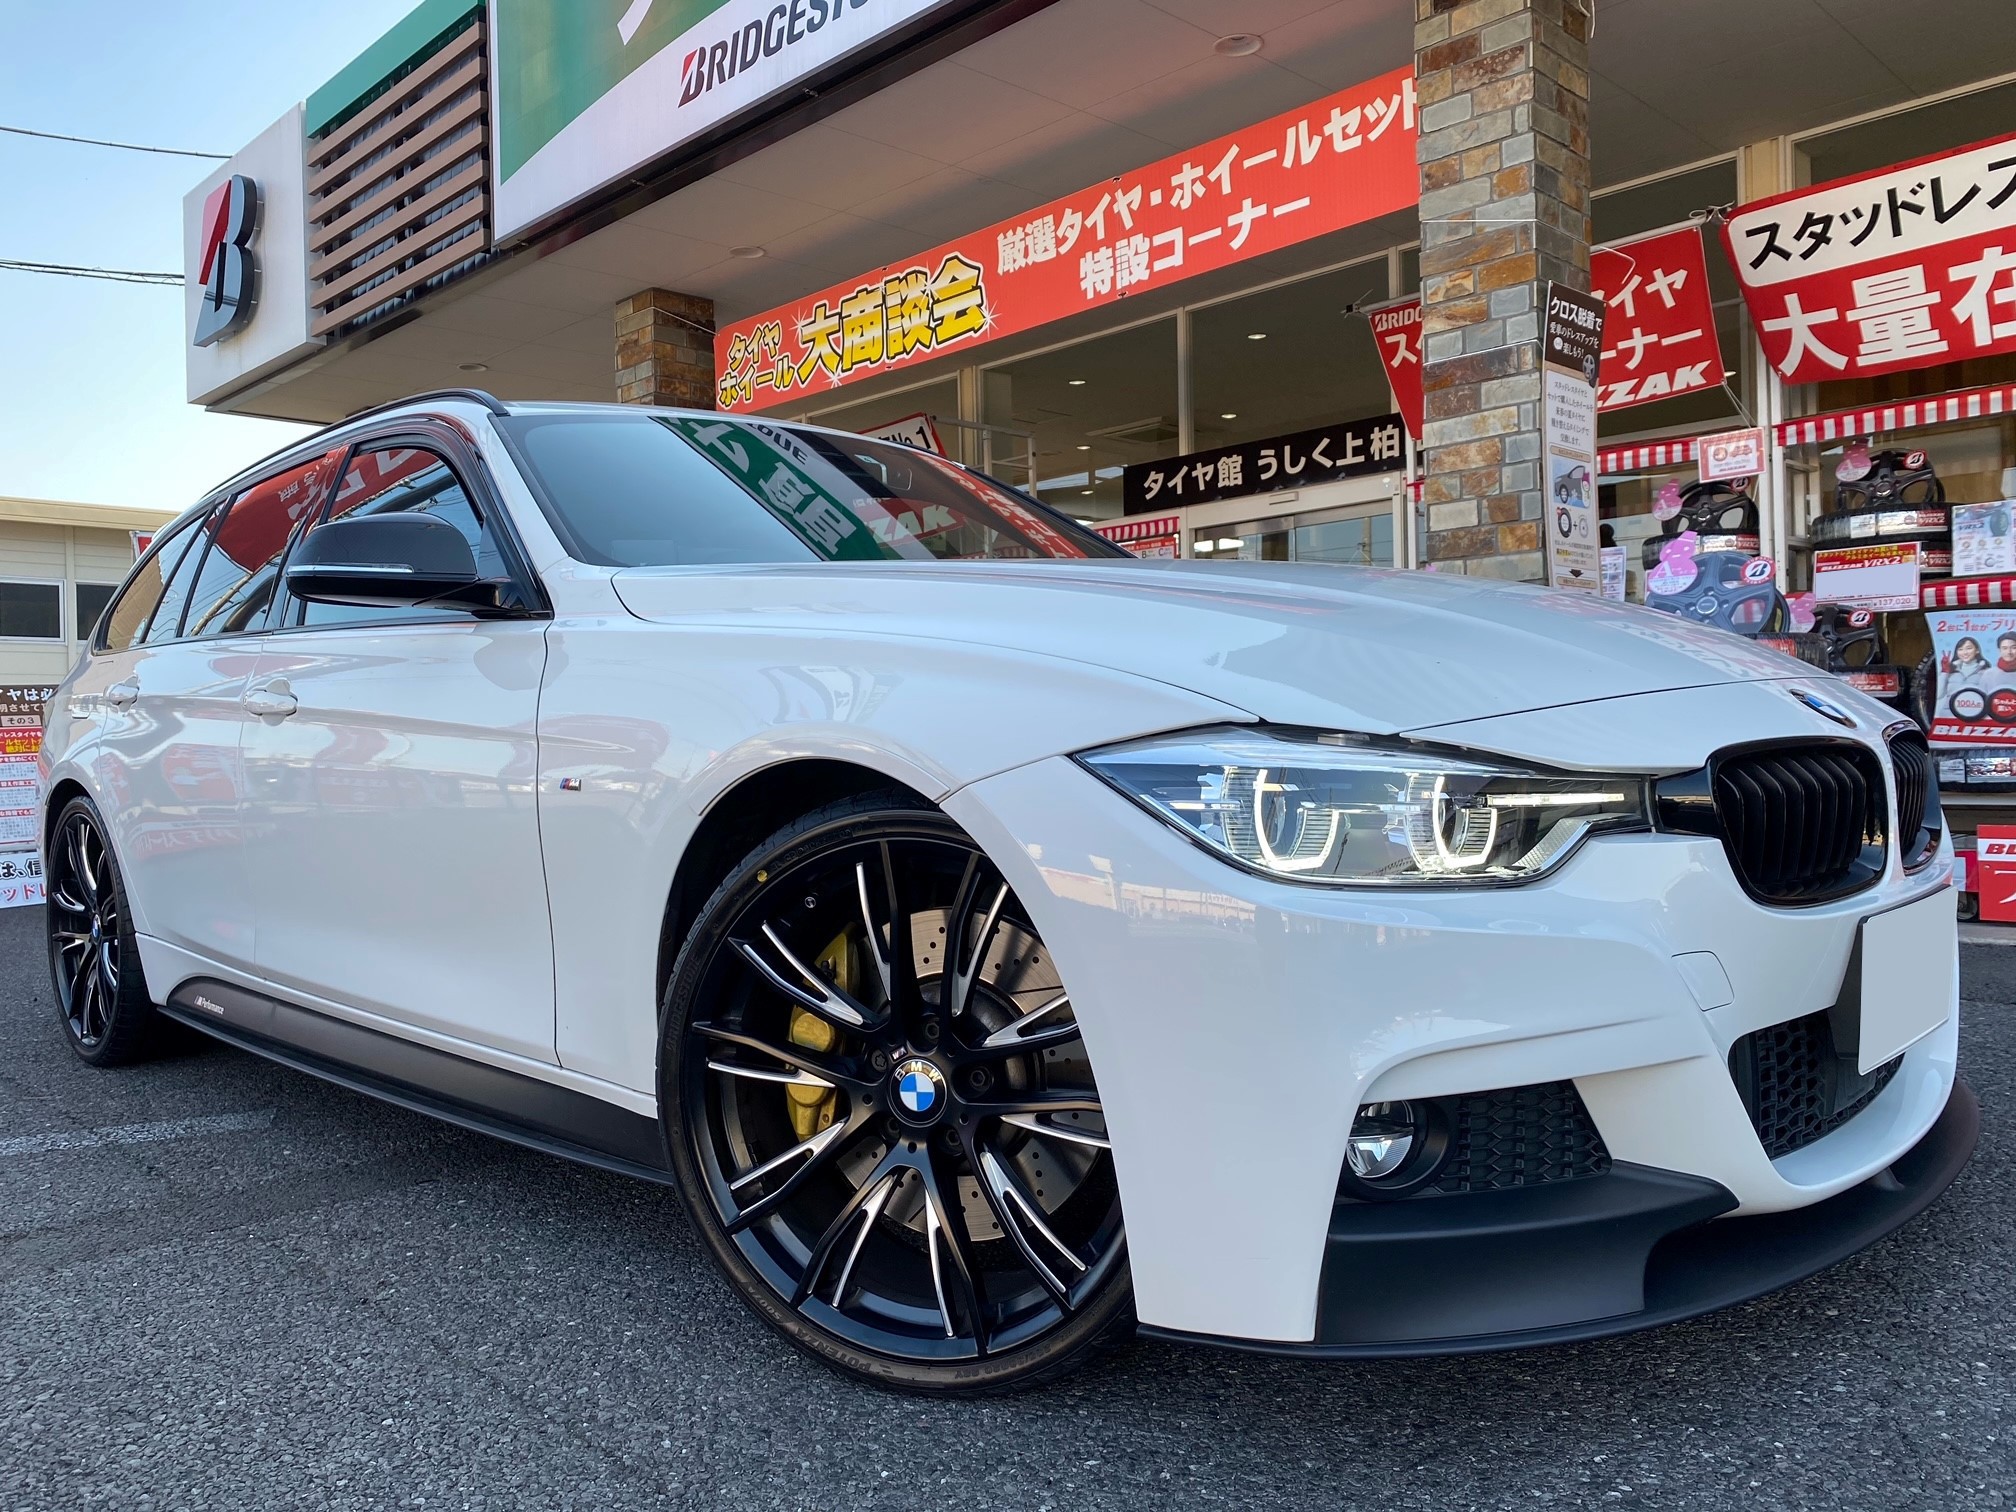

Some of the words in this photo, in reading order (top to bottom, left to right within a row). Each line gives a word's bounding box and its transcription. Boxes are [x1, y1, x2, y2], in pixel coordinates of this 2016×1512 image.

[678, 0, 868, 108] BRIDGES
[997, 77, 1418, 275] 厳選タイヤ・ホイールセット
[1079, 196, 1311, 299] 特設コーナー
[1550, 296, 1603, 332] クロス脱着で
[1591, 267, 1689, 319] イヤ
[797, 253, 988, 386] 大商談会
[1549, 321, 1600, 349] 愛車のドレスアップを
[728, 321, 782, 373] タイヤ
[1384, 330, 1424, 368] ス
[718, 354, 796, 408] ホイール
[1143, 454, 1244, 501] タイヤ館
[1257, 424, 1401, 481] うしく上柏
[1862, 556, 1901, 567] VRX2
[0, 688, 53, 701] ヤは必
[7, 717, 35, 725] その3
[0, 860, 42, 878] は、信
[894, 1061, 942, 1083] BMW
[795, 1326, 872, 1374] POTENZA
